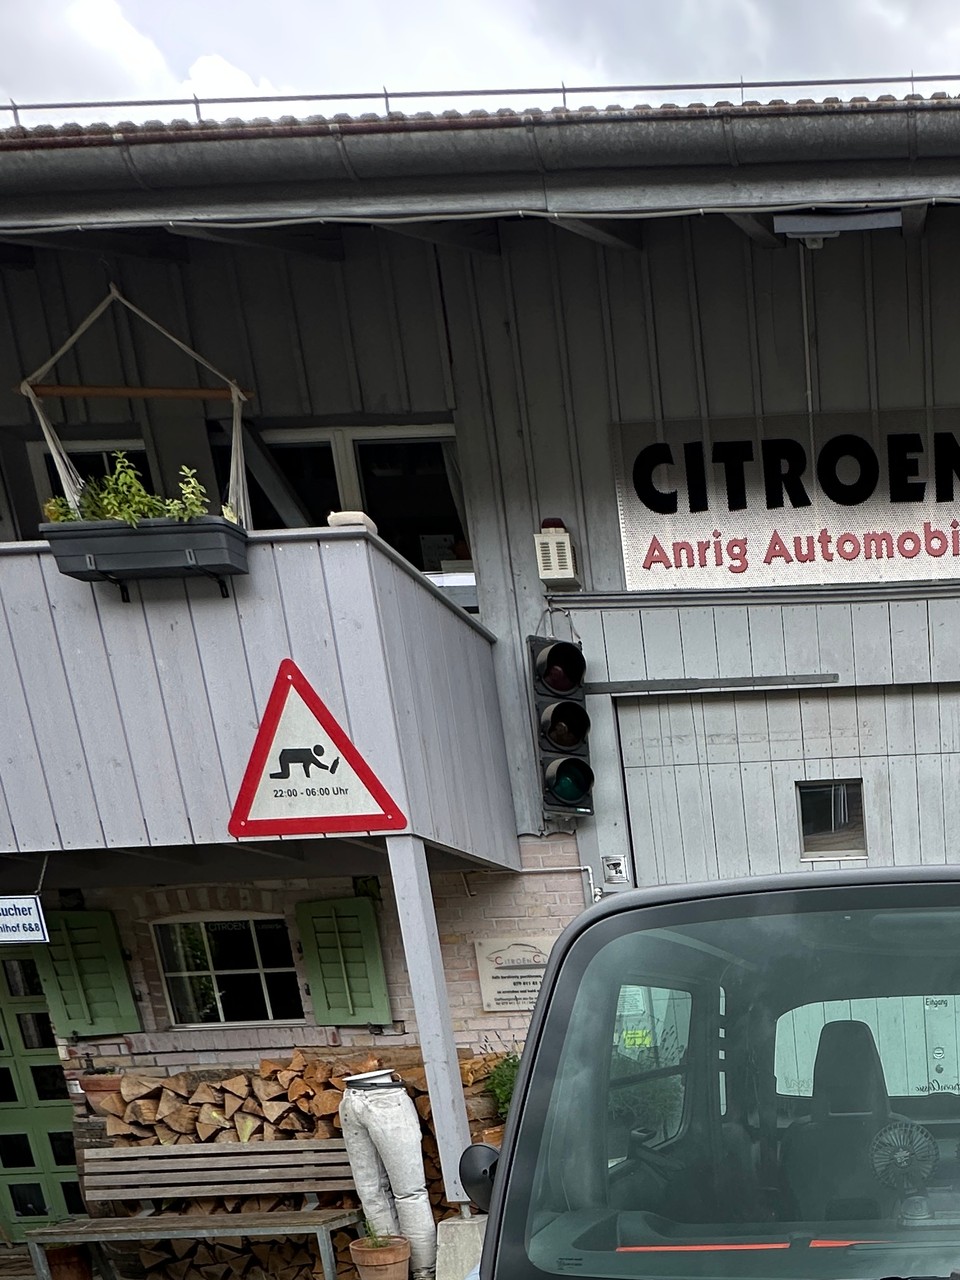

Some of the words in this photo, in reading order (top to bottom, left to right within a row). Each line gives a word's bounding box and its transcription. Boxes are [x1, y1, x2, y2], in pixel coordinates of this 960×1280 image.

[642, 529, 749, 574] Anrig
[273, 788, 298, 798] 22:00
[305, 787, 330, 797] 06:00
[332, 786, 349, 796] Uhr
[22, 922, 40, 932] 6&8
